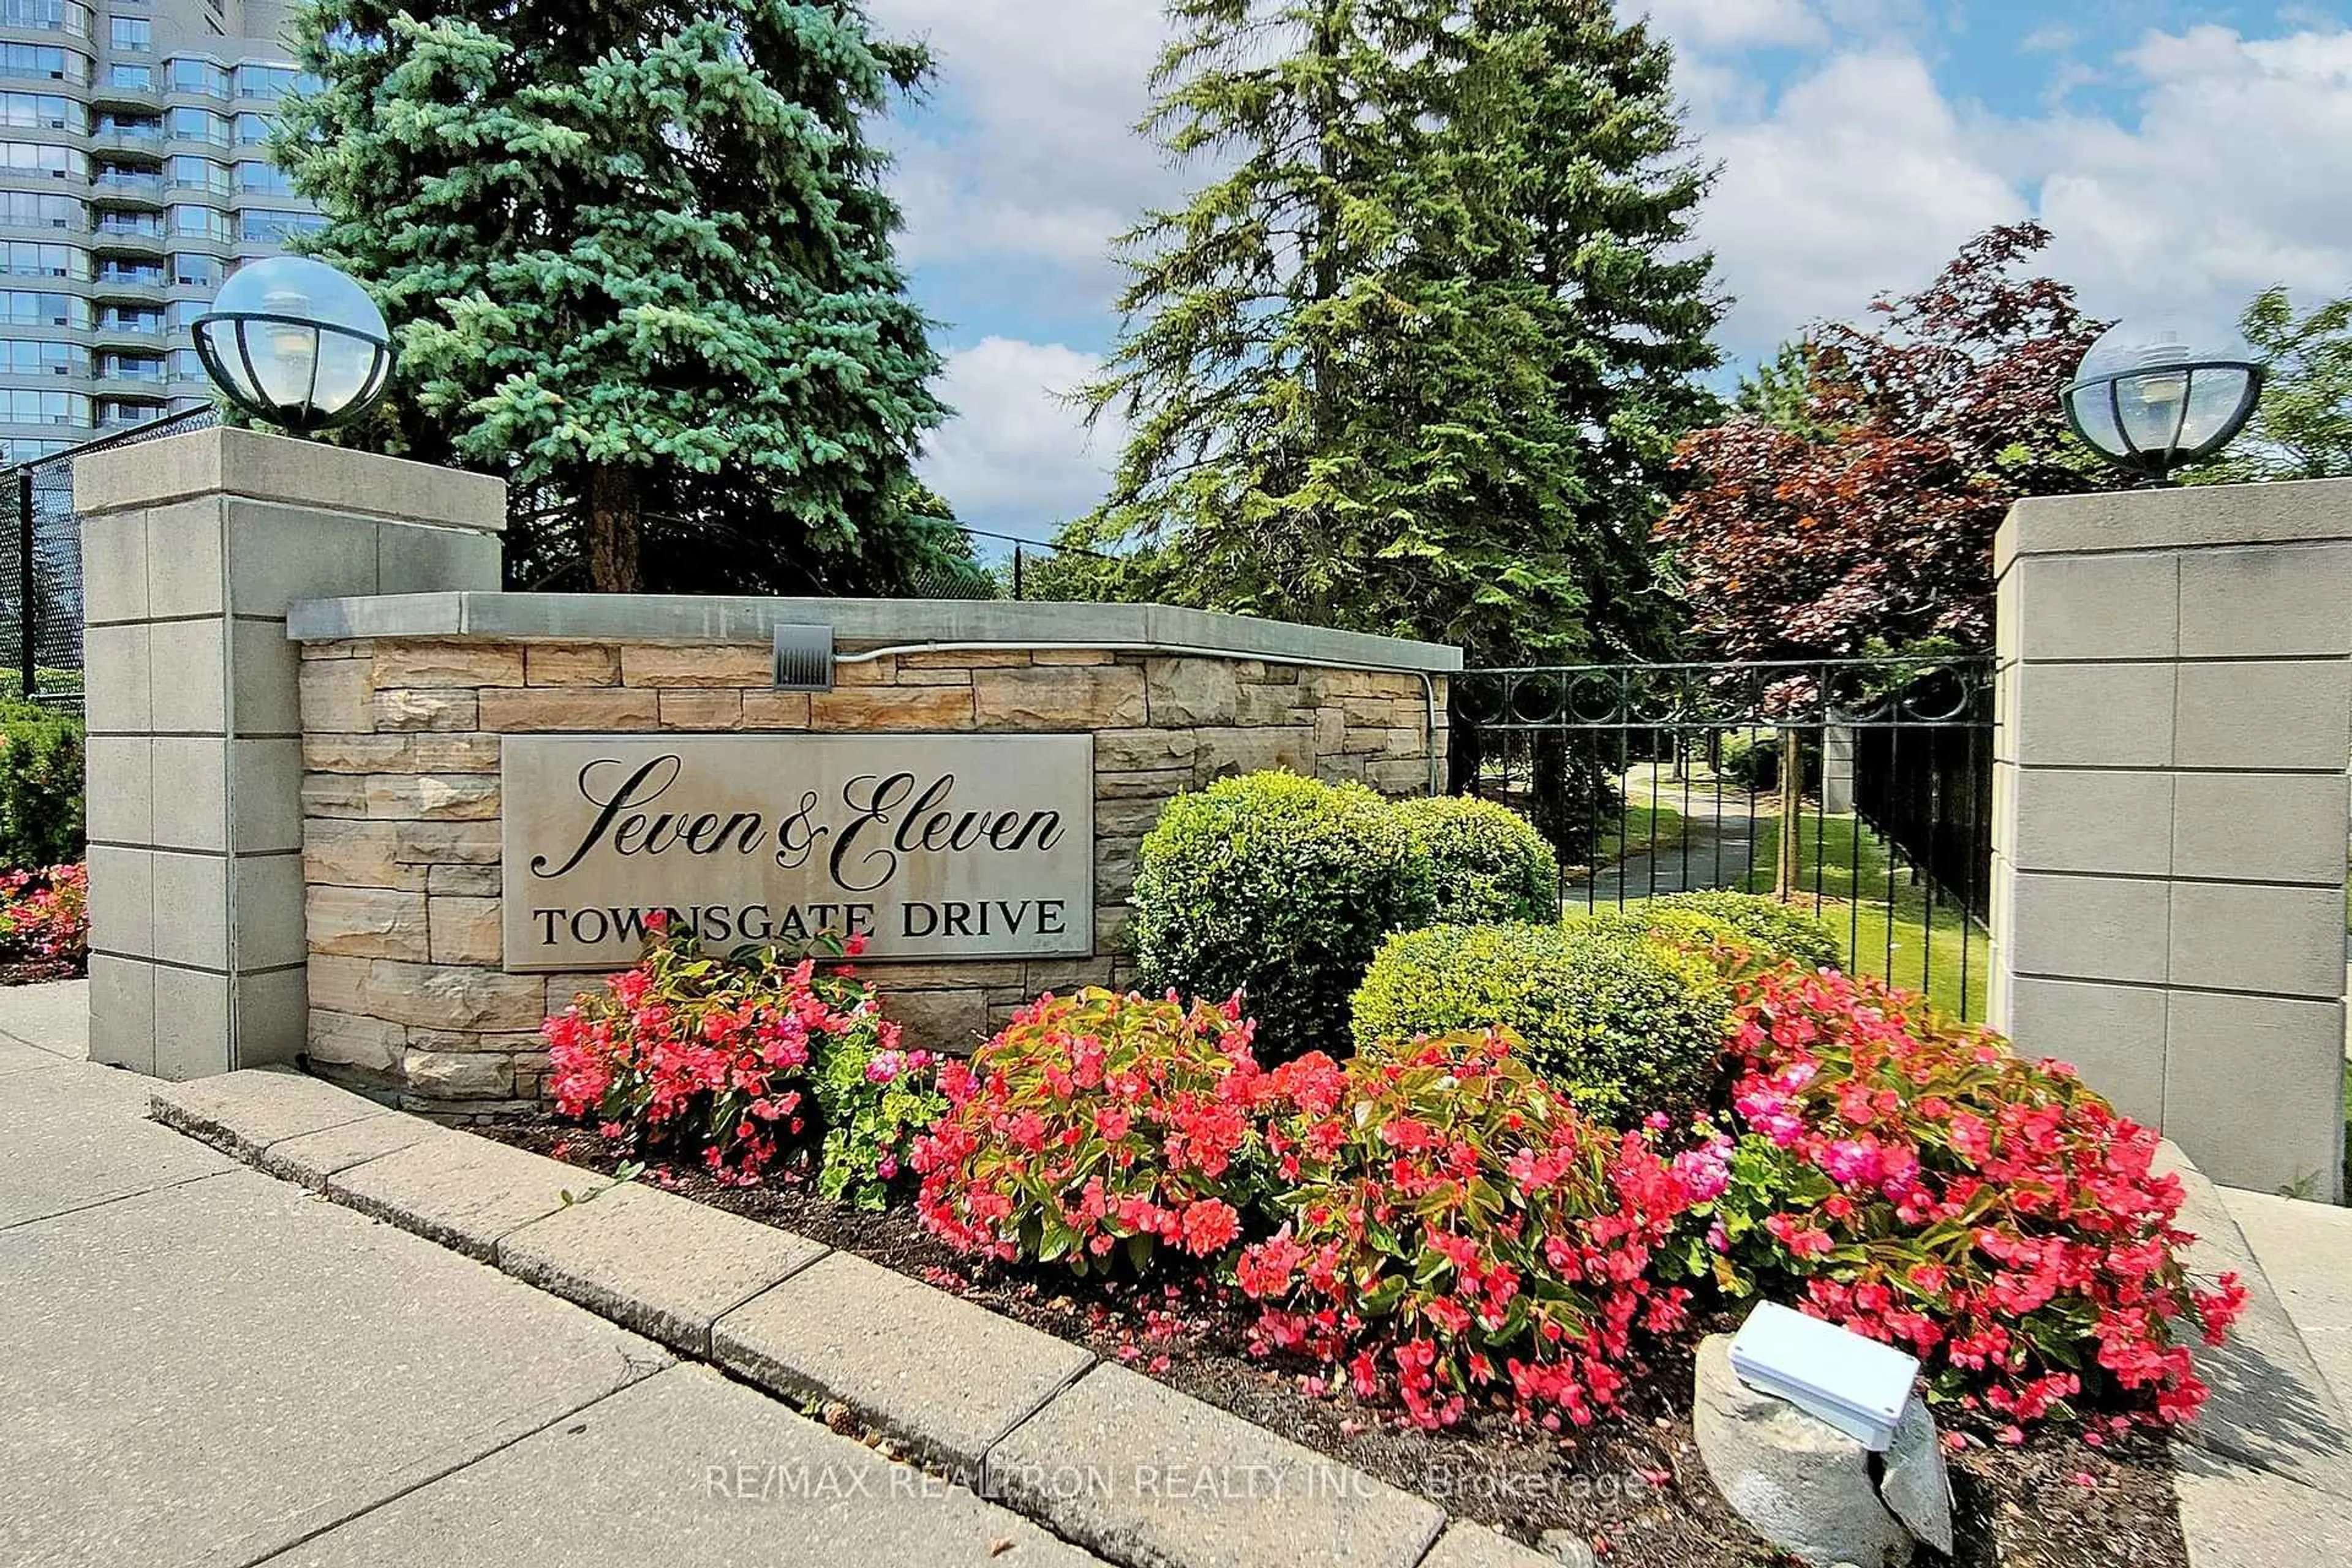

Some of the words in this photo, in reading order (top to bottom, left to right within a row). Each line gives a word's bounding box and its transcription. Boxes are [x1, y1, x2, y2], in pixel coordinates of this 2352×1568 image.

[530, 754, 767, 879] Seven
[775, 791, 829, 869] &
[829, 772, 1065, 891] Eleven
[533, 903, 875, 944] TOWNSGATE
[902, 900, 1066, 937] DRIVE
